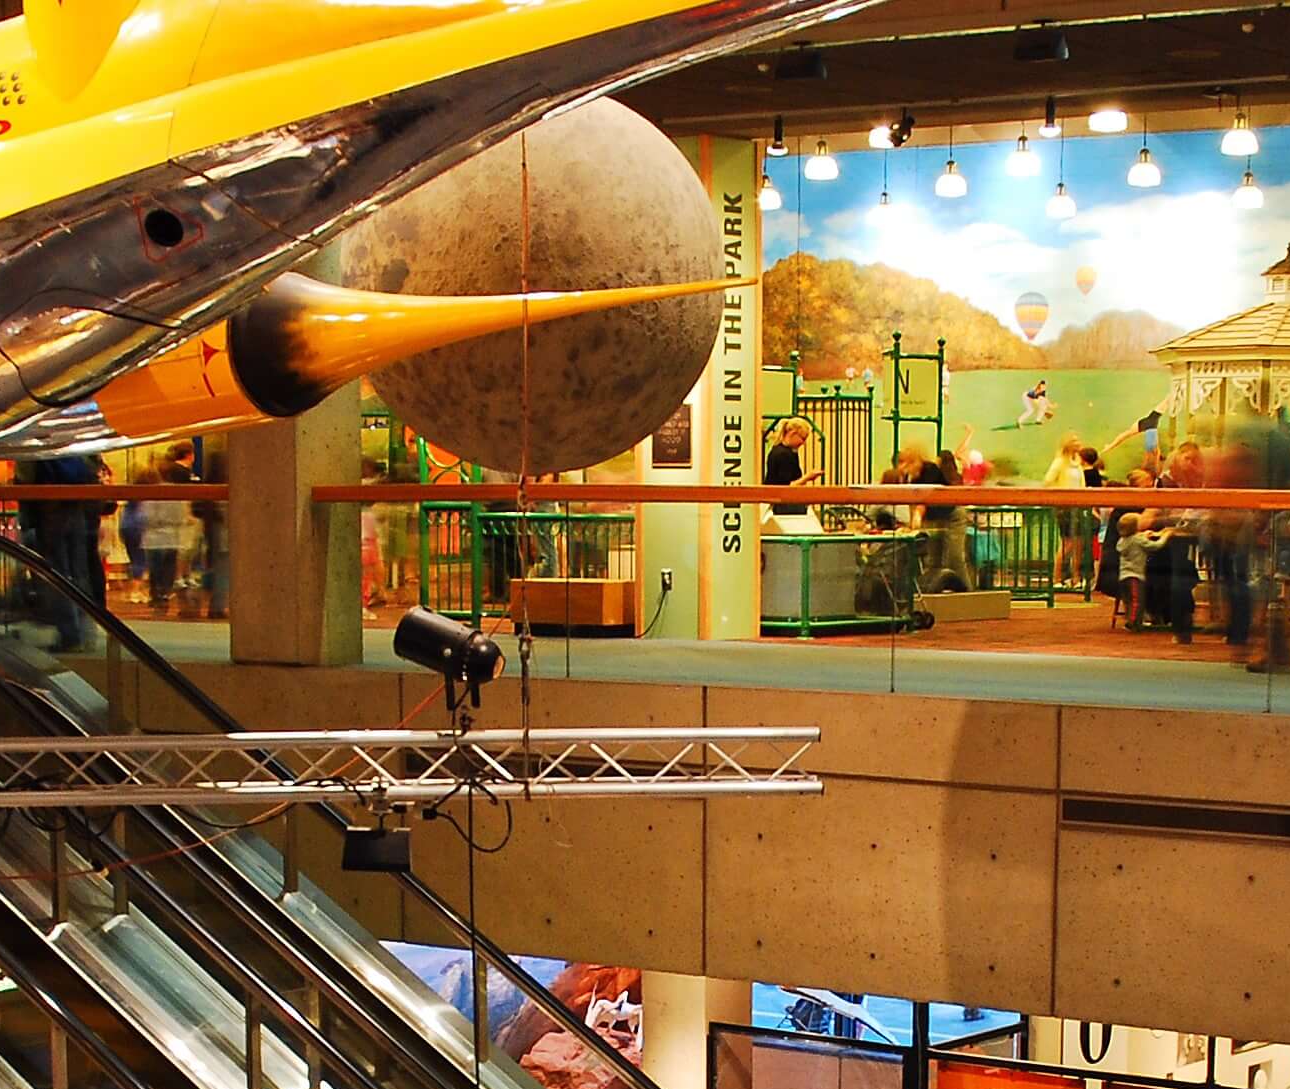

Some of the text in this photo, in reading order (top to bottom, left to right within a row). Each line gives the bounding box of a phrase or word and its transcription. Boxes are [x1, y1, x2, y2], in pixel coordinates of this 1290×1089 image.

[723, 192, 742, 553] SCINCE IN THE PARK
